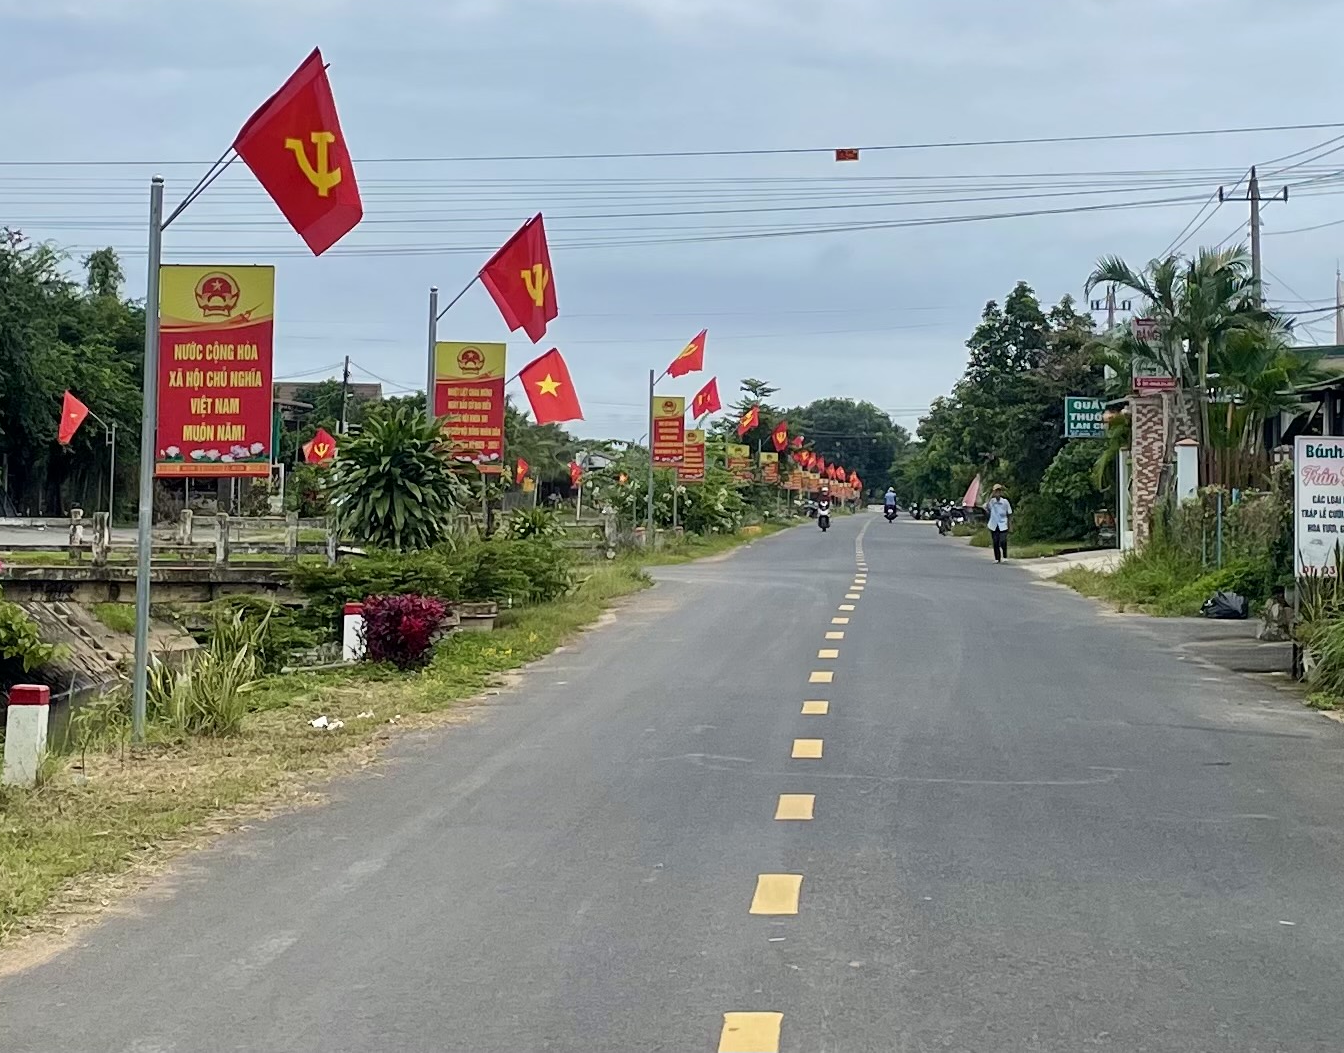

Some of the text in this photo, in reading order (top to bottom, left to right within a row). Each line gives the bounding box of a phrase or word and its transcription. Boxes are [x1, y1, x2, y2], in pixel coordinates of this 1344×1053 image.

[174, 341, 203, 360] NƯỚC
[206, 341, 235, 364] CỘNG
[169, 366, 262, 391] XÃ HỘI CHỦ NGHĨA
[190, 395, 240, 418] VIỆT NAM
[1305, 444, 1344, 459] Bánh
